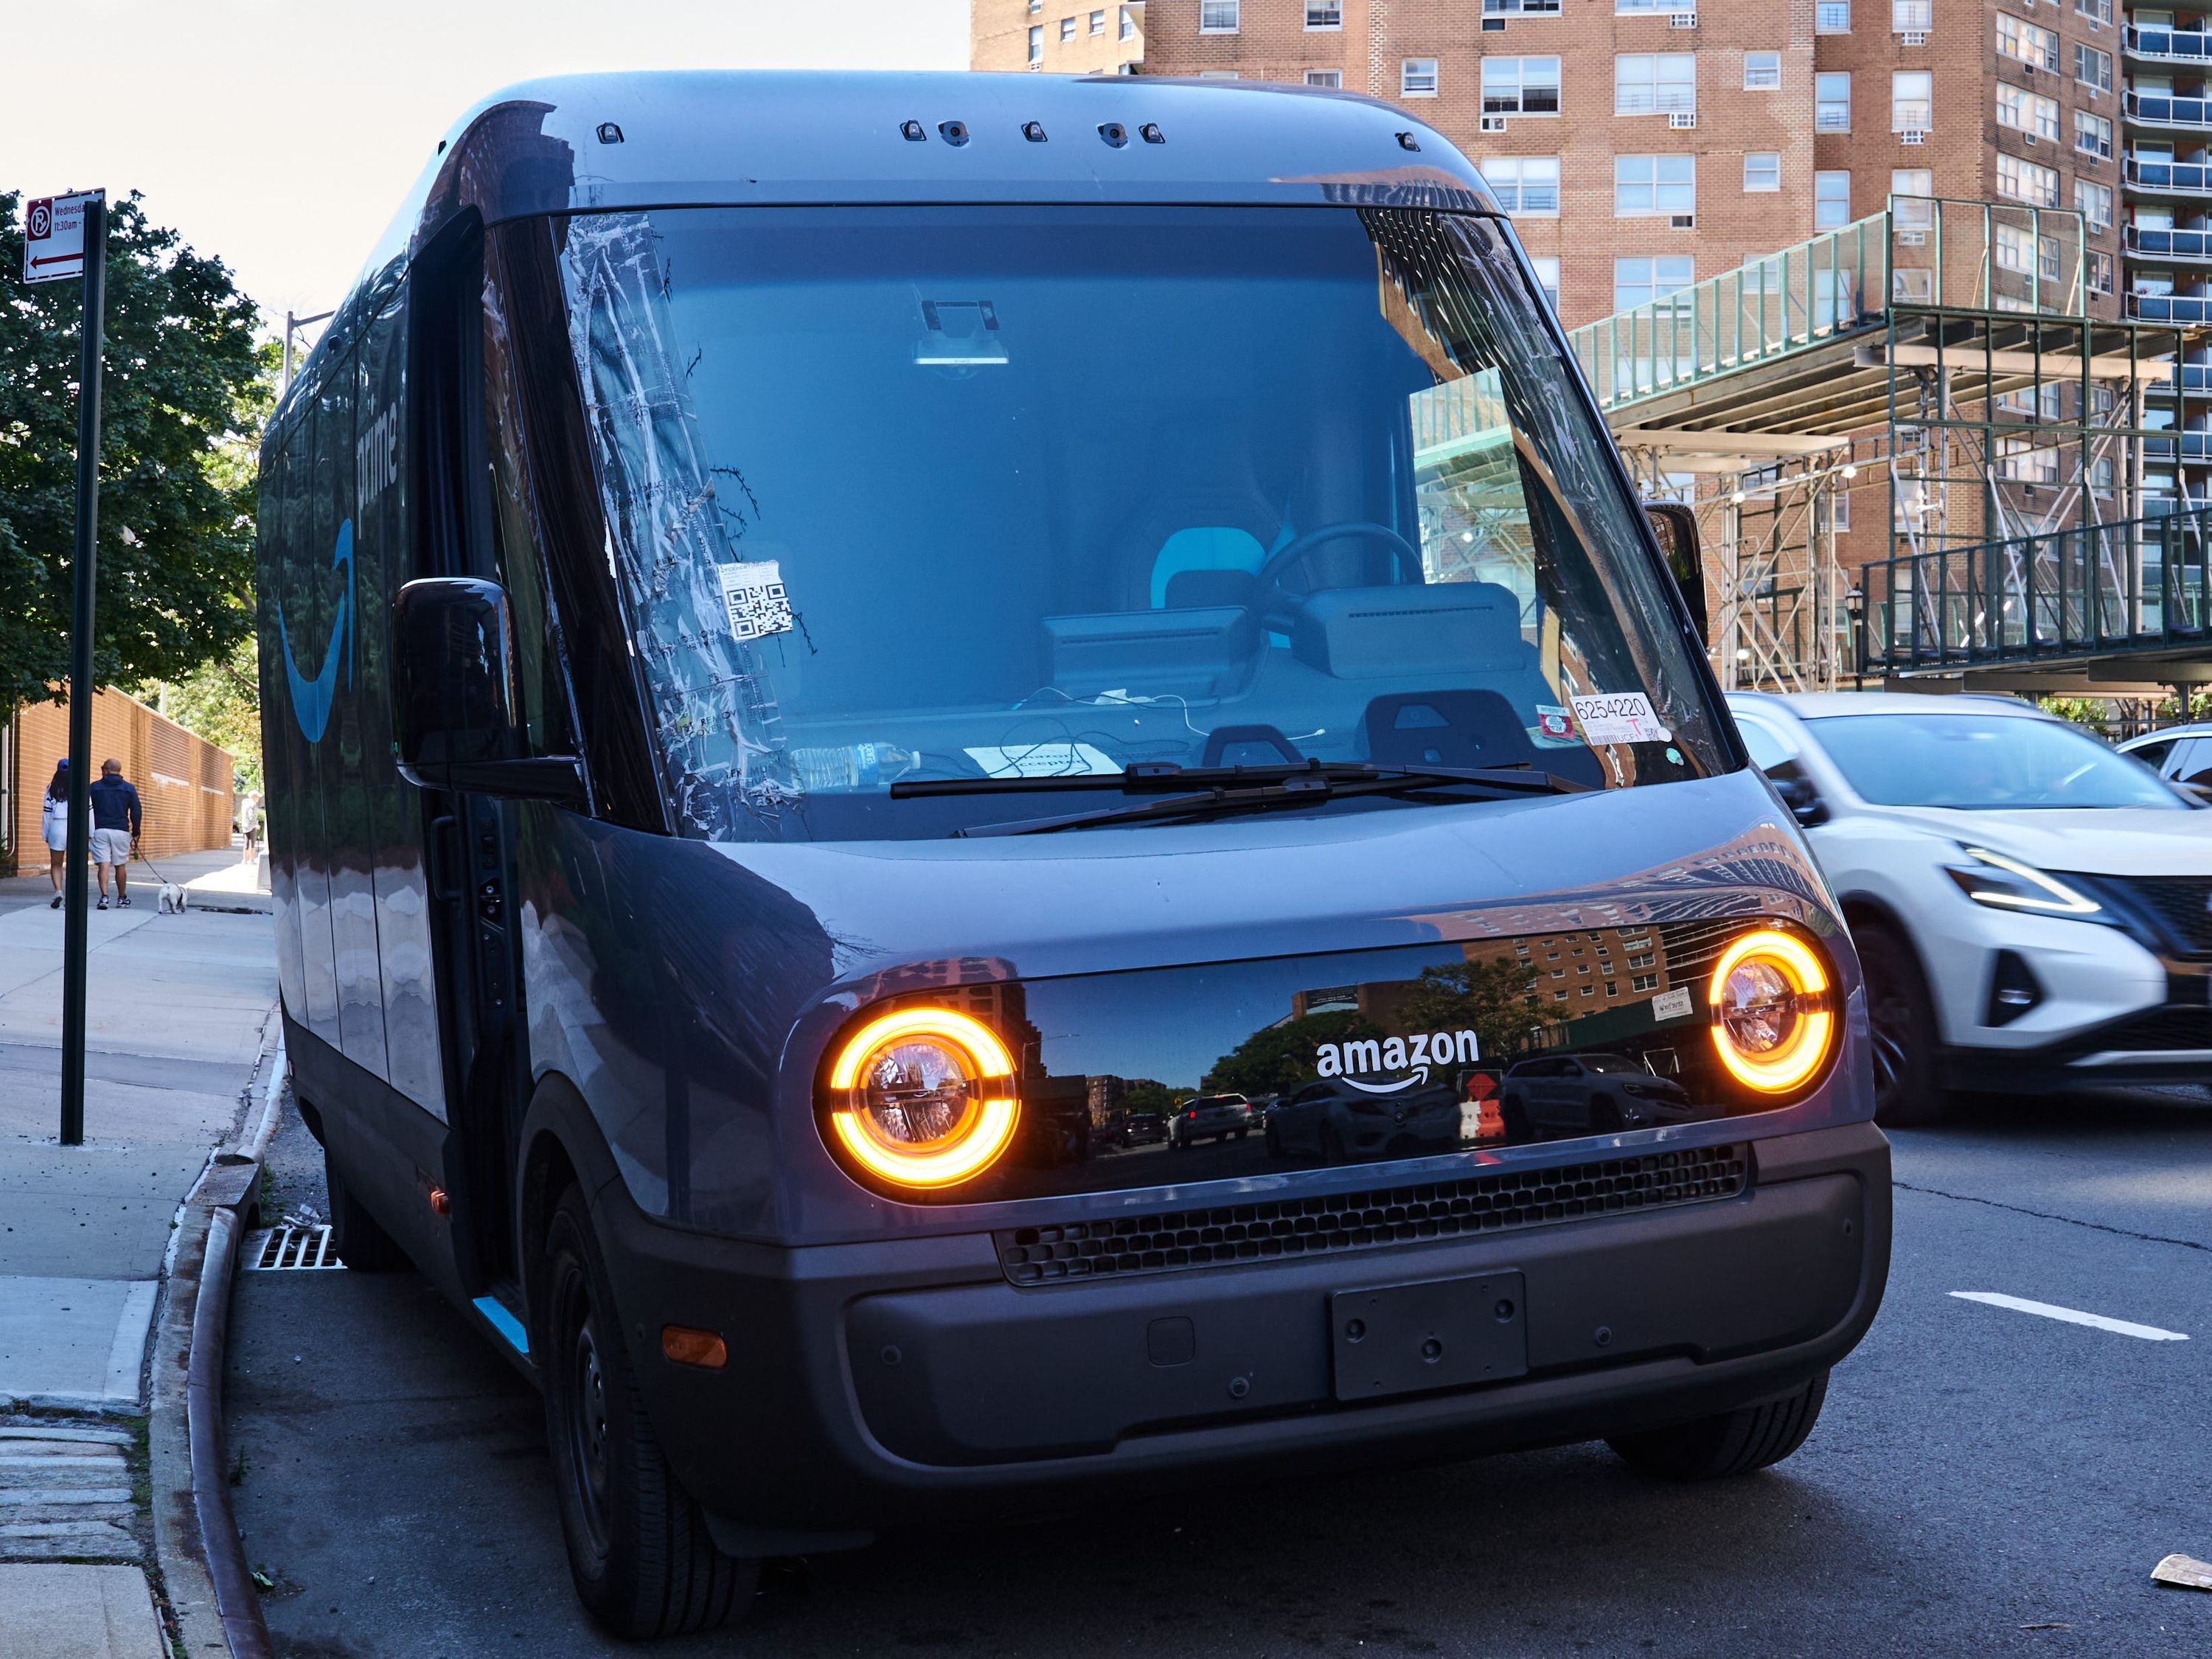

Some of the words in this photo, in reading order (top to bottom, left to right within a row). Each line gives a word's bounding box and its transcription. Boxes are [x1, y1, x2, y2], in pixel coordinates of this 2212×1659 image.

[55, 204, 85, 216] Wednesda
[358, 394, 397, 540] prime
[1576, 698, 1646, 720] 6254220
[1316, 1029, 1479, 1077] amazon
